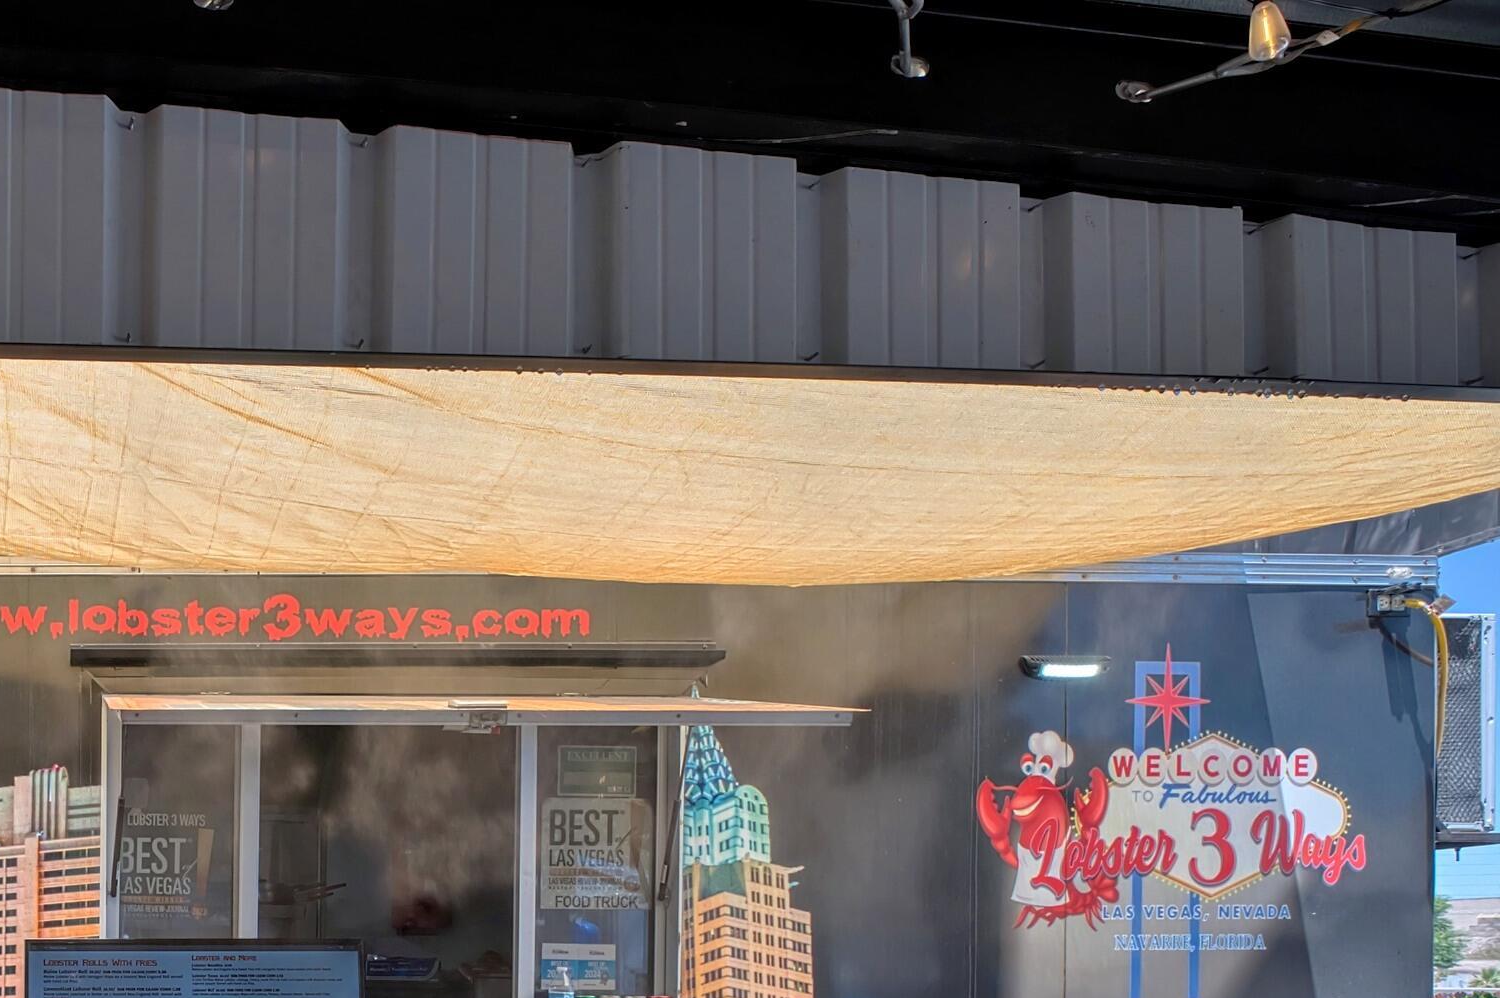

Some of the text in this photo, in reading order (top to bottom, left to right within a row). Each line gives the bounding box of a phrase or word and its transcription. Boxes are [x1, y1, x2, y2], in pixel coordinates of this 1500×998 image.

[1112, 754, 1311, 778] WELCOME
[1131, 783, 1277, 809] TO Fabulous
[127, 813, 206, 827] LOBSTER 3 WAYS
[549, 809, 619, 847] BEST
[120, 837, 187, 874] BEST
[549, 849, 624, 867] LAS VEGAS
[1029, 807, 1368, 900] Lobster 3 Ways
[121, 877, 192, 895] AS VEGAS
[555, 895, 638, 909] FOOD TRUCK
[1102, 904, 1136, 920] LAS
[1217, 904, 1292, 920] NEVADA
[1199, 933, 1267, 951] FLORIDA
